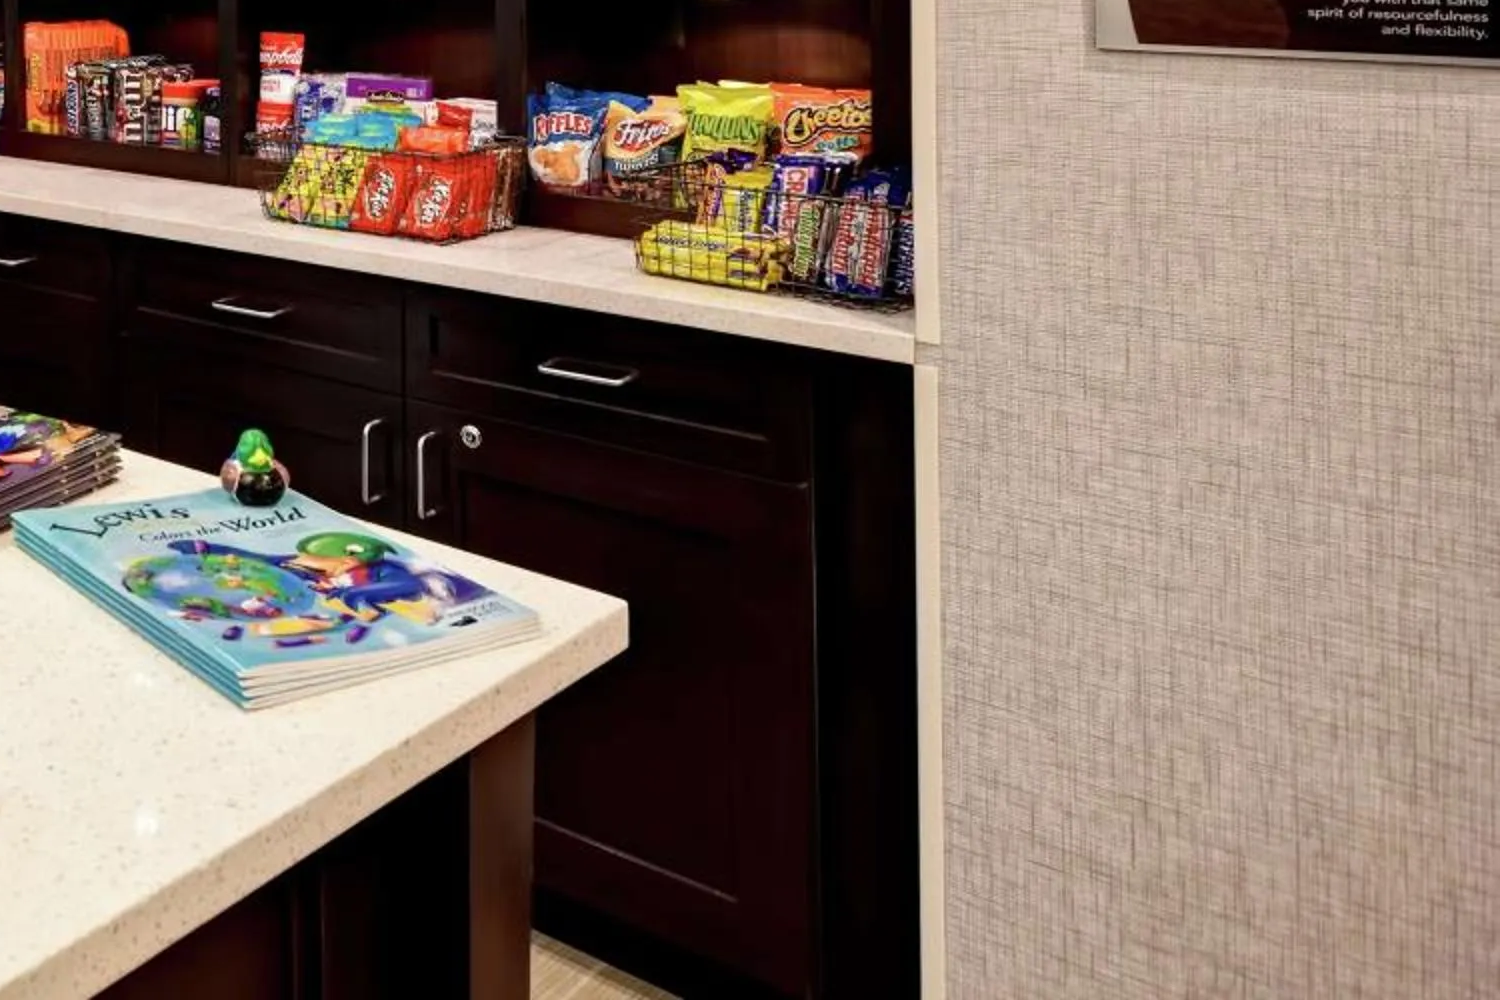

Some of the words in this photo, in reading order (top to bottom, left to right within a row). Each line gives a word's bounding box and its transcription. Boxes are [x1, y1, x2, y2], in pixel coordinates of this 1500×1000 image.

[1308, 8, 1343, 22] spirit
[1349, 8, 1363, 19] of
[1368, 9, 1488, 24] resourcefulness
[1381, 24, 1410, 35] and
[1415, 25, 1488, 41] flexibility.
[615, 117, 672, 147] Fritos
[50, 503, 191, 538] Lewis
[139, 529, 192, 543] Colors
[195, 524, 220, 537] the
[220, 506, 308, 533] World
